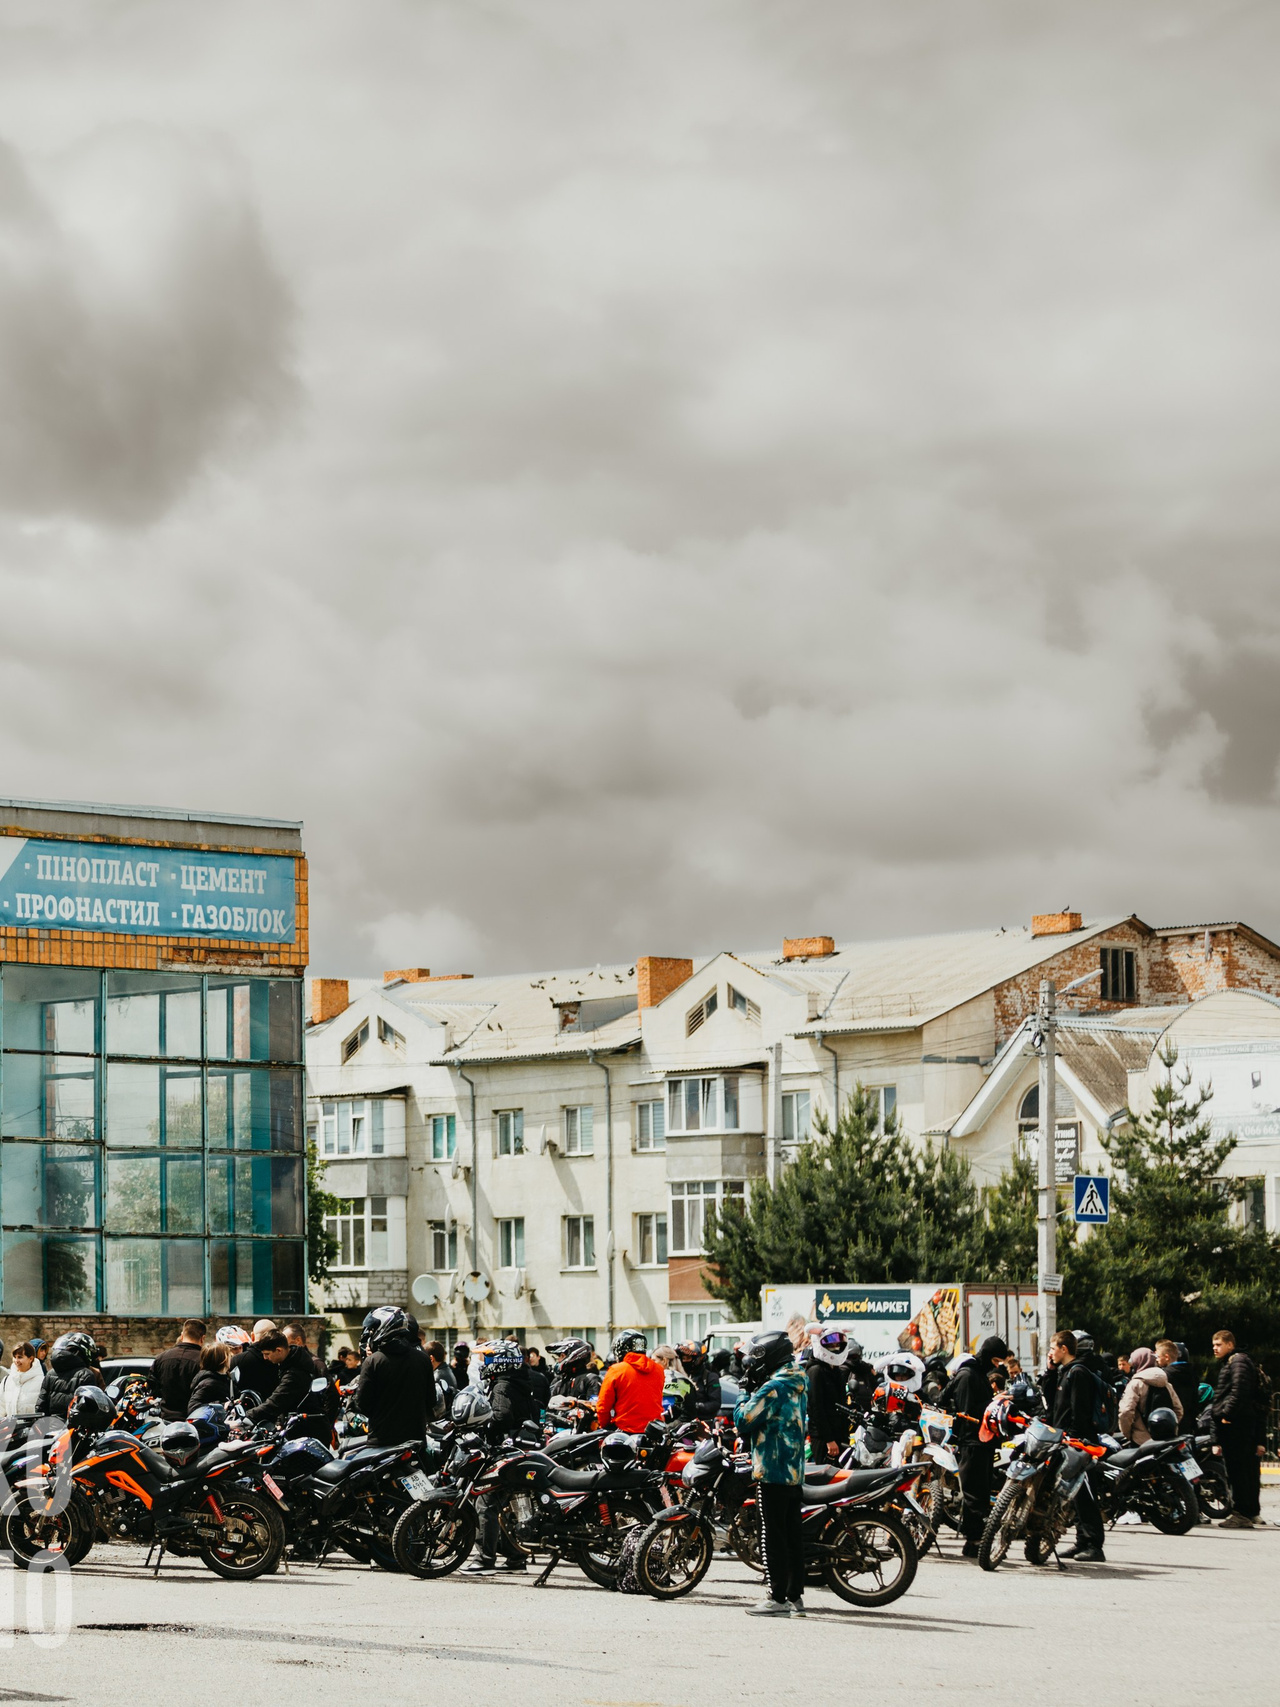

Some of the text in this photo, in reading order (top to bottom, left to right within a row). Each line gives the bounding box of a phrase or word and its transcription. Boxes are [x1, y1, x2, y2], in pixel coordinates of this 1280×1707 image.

[37, 855, 267, 897] ПІНОПЛАСТ ЦЕМЕНТ
[15, 893, 287, 935] ПРОФНАСТИЛ ГАЗОБЛОК
[1245, 1125, 1261, 1136] 066
[1263, 1124, 1279, 1135] 662
[836, 1298, 909, 1314] М'ЯСОМАРКЕТ
